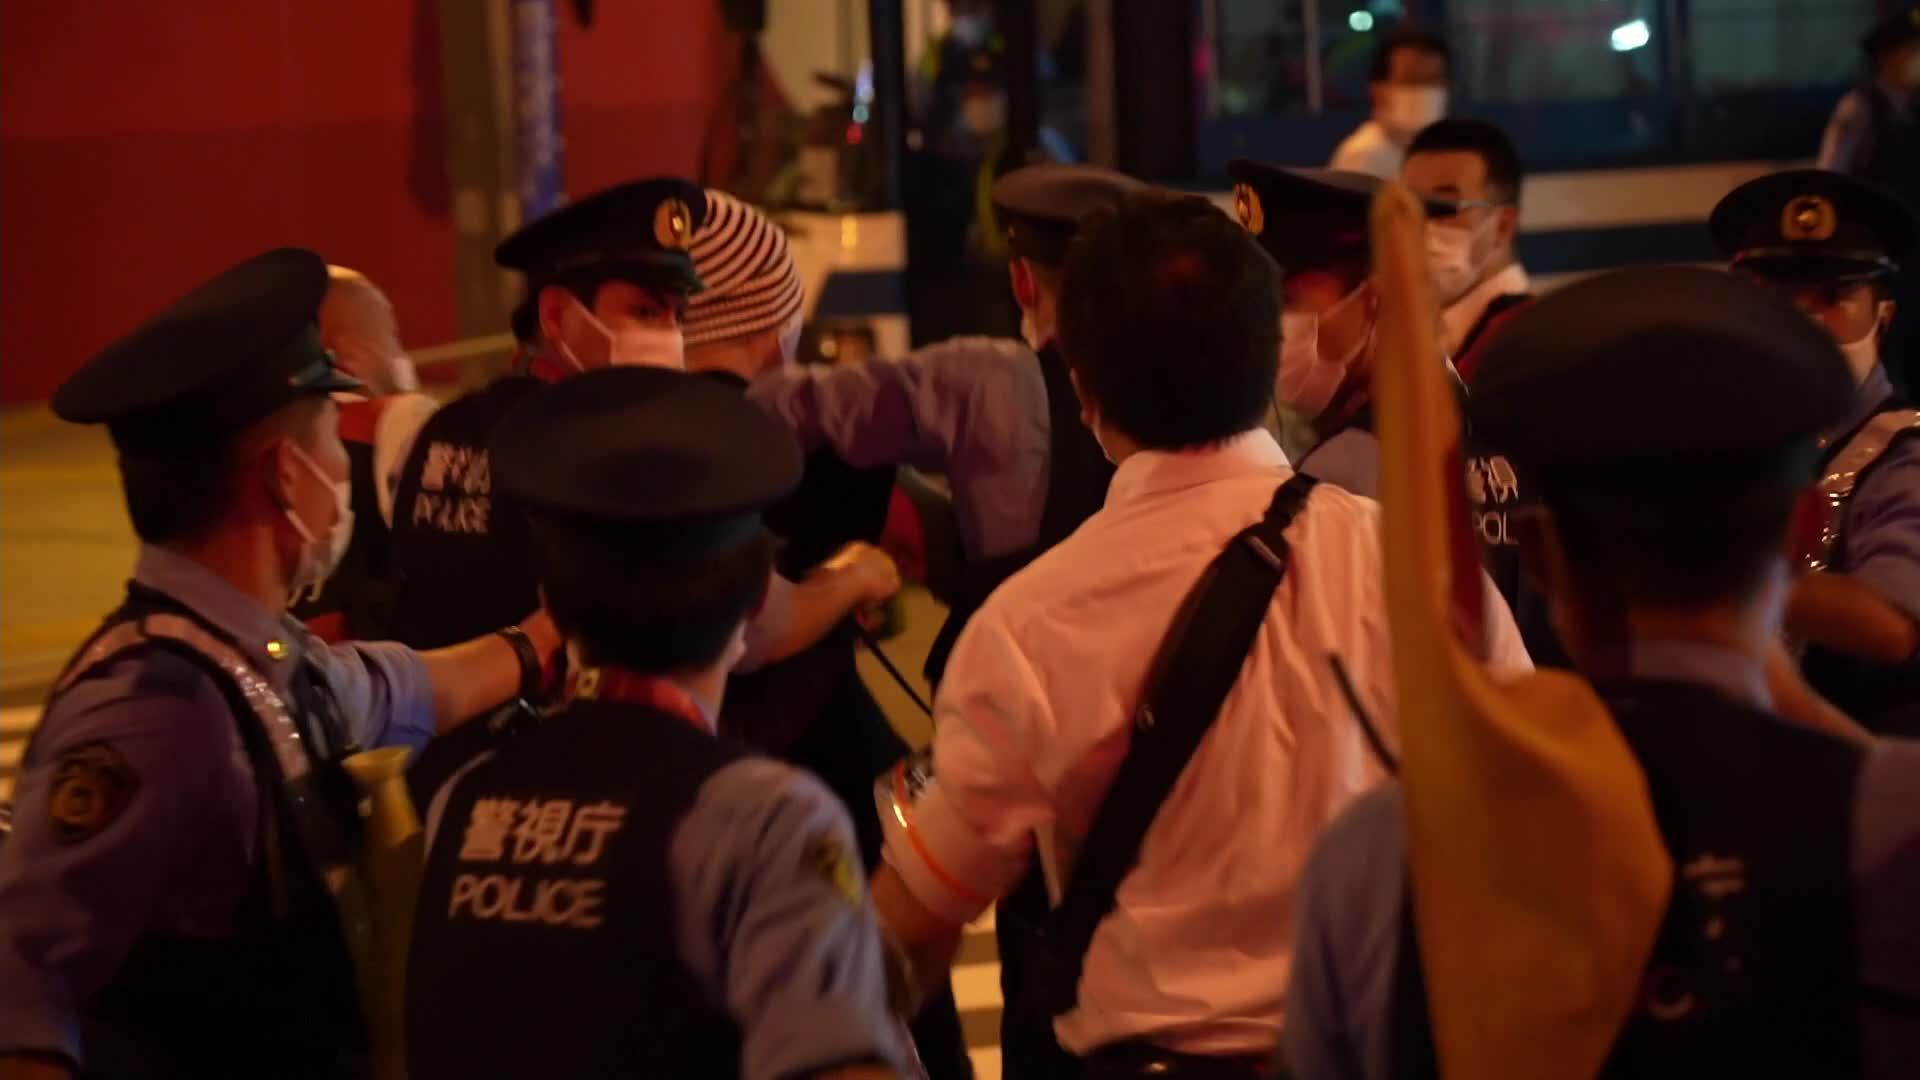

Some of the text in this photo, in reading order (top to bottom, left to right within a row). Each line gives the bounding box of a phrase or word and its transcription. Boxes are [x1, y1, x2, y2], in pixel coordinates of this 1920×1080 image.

[1472, 510, 1521, 545] POL
[458, 796, 628, 866] 警視庁
[448, 872, 608, 928] POLICE
